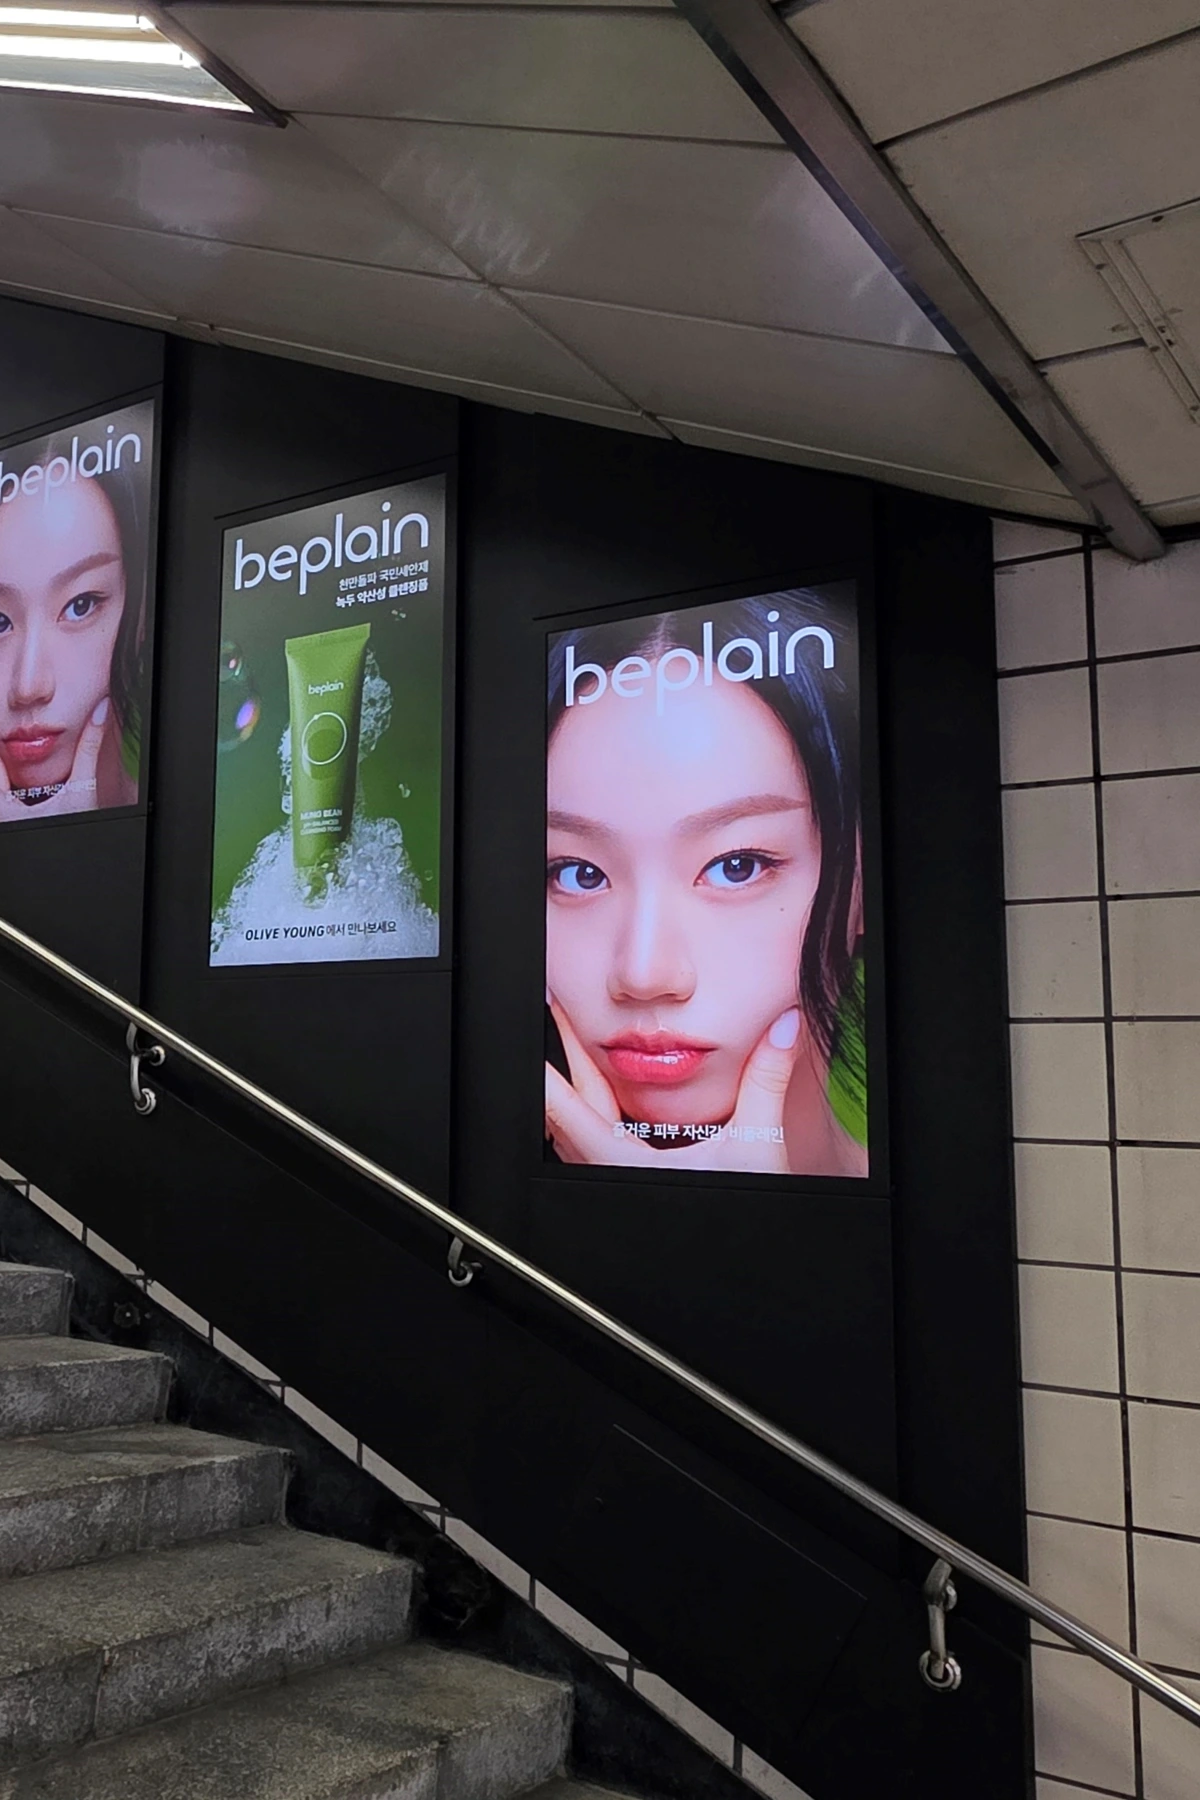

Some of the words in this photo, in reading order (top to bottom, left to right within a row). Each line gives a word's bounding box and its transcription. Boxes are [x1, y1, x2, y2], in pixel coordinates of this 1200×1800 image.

[234, 501, 429, 595] beplain
[379, 560, 429, 581] 국민세안제
[357, 587, 386, 604] 약산성
[565, 610, 835, 716] beplain
[308, 680, 344, 696] beplain
[323, 808, 342, 818] BEAN
[245, 928, 280, 941] OLIVE
[347, 920, 397, 936] 만나보세요
[612, 1122, 652, 1139] 즐거운
[653, 1123, 681, 1140] 피부
[729, 1126, 785, 1144] 비플레인
